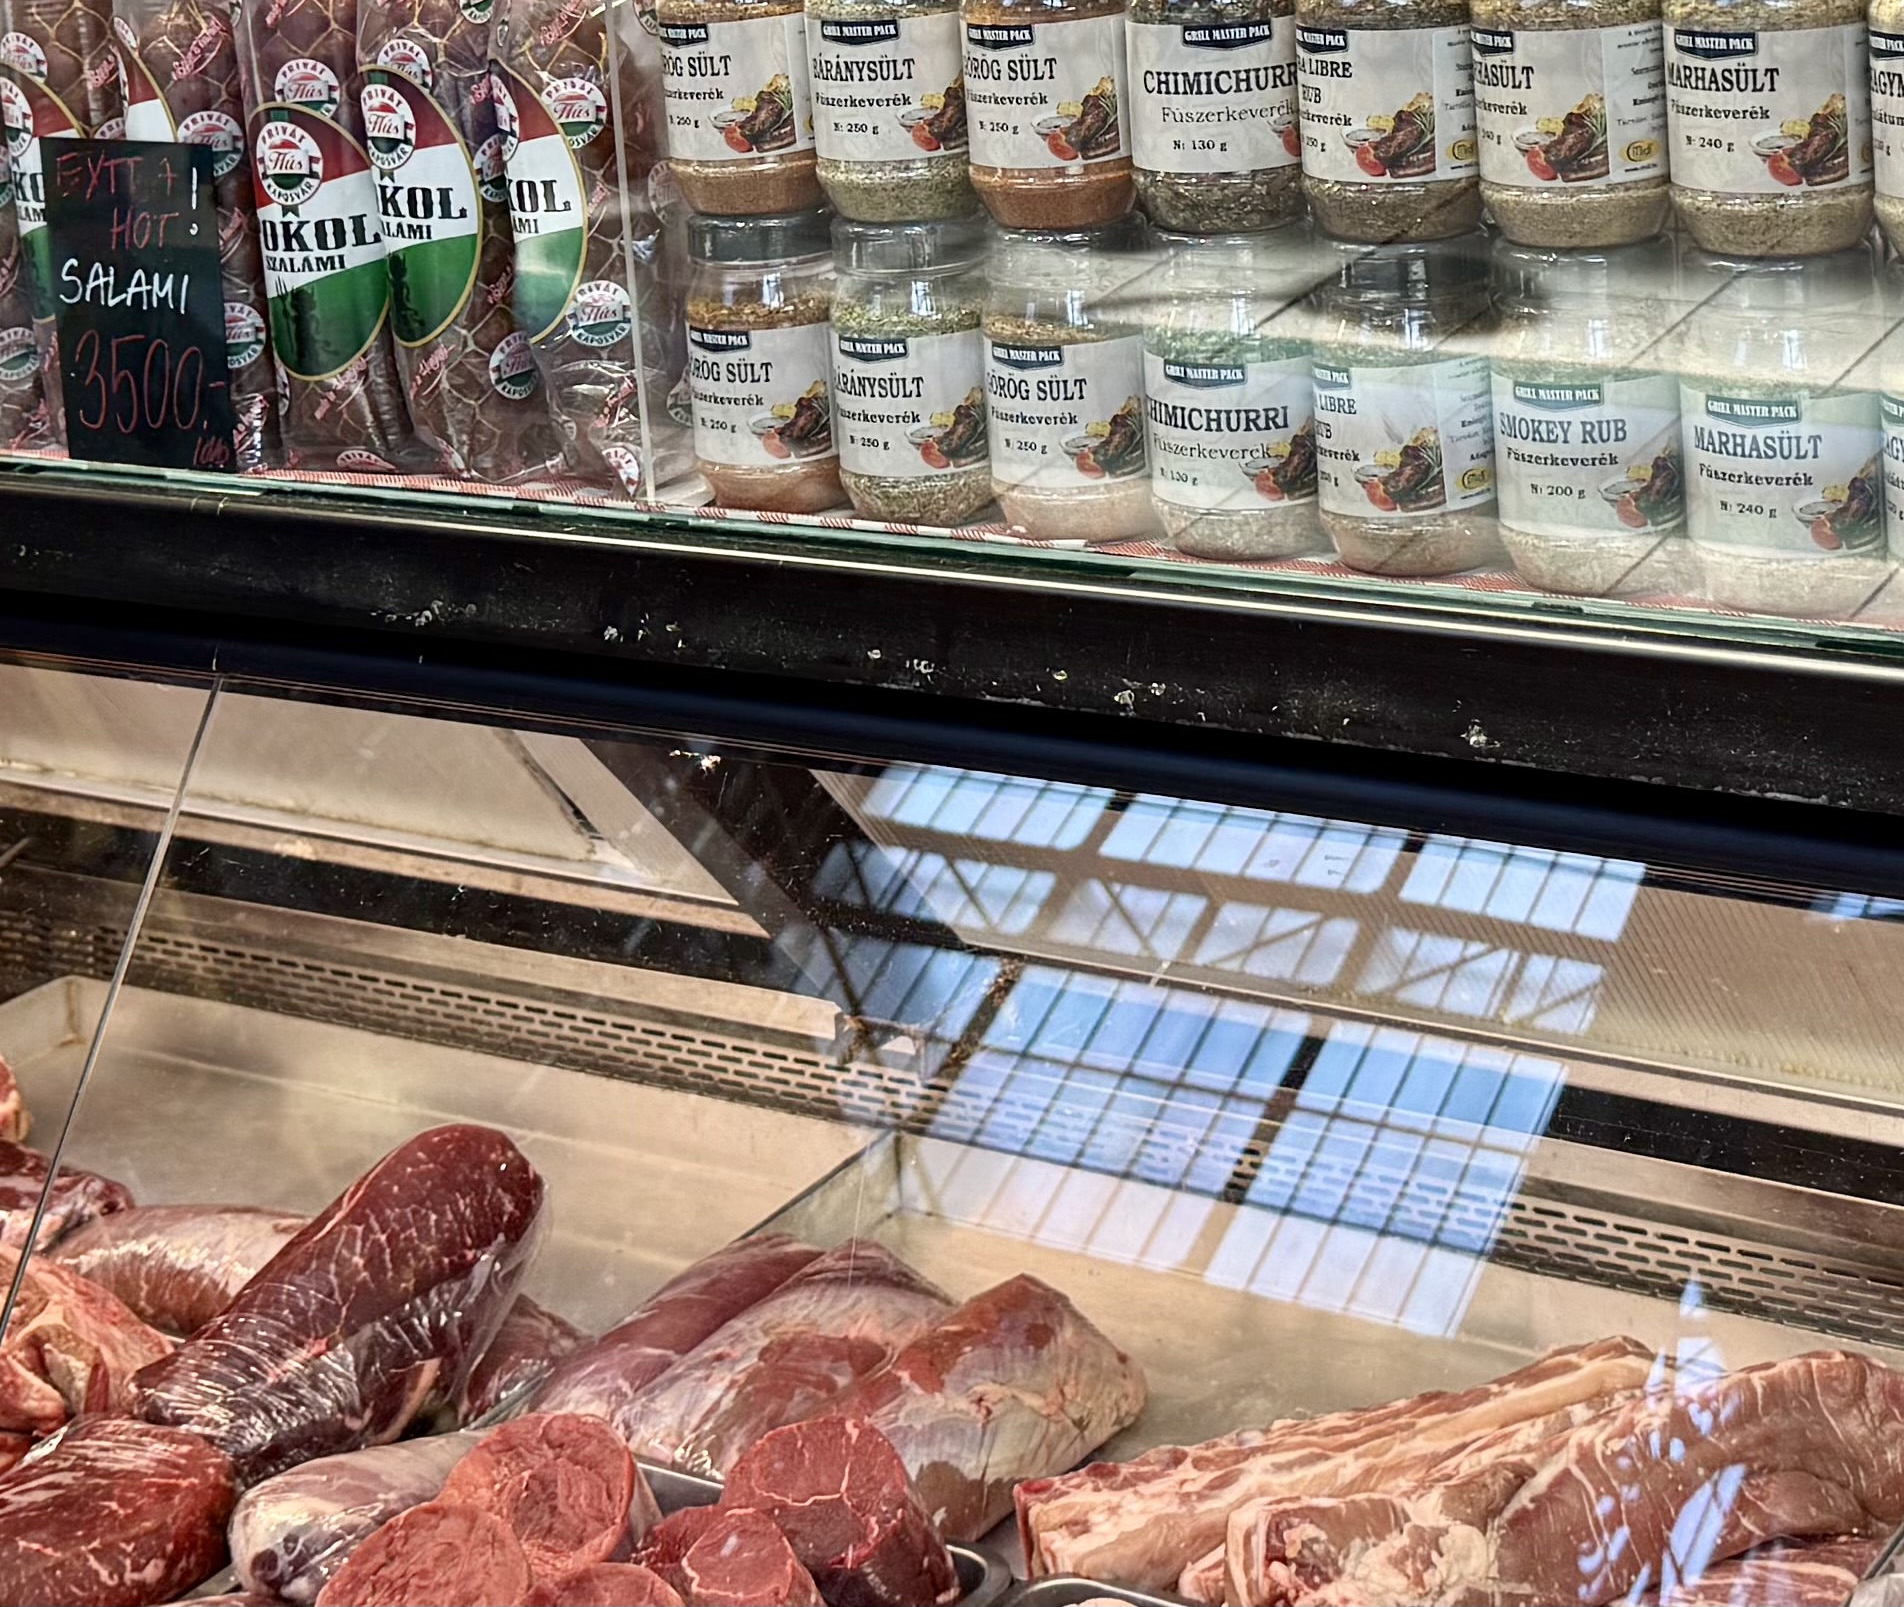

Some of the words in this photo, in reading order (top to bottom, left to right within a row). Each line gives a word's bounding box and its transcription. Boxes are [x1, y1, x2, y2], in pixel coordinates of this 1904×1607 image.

[688, 49, 732, 78] SÜLT
[1007, 53, 1058, 81] SÜLT
[1143, 60, 1297, 96] CHIMICHURR
[59, 257, 189, 315] SALAMI
[727, 357, 773, 384] SÜLT
[836, 365, 924, 399] ÁRÁNYSÜLT
[1036, 374, 1088, 402] SÜLT
[1149, 398, 1289, 433] HIMICHURRI
[1499, 411, 1572, 444] SMOKEY
[1581, 418, 1627, 444] RUB
[1693, 424, 1823, 461] MARHASÜLT
